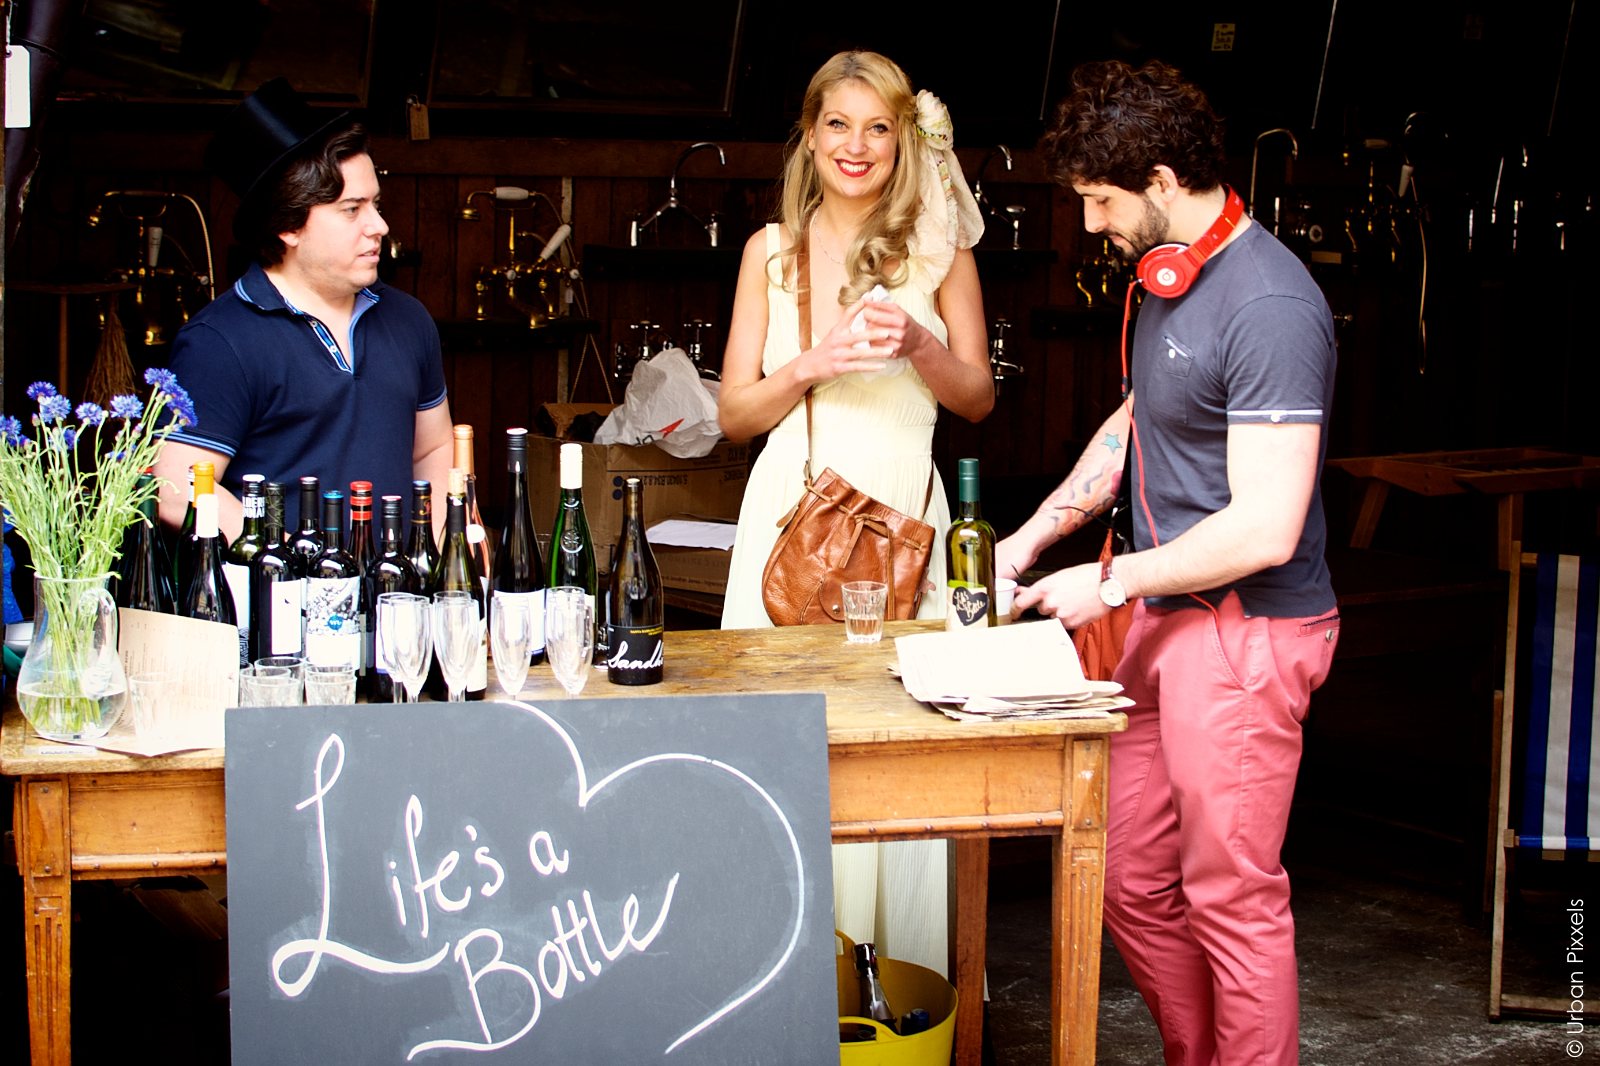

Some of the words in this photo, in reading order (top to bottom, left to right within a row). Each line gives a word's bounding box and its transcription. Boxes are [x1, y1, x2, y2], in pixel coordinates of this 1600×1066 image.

[272, 733, 504, 997] Life's
[528, 831, 568, 875] a
[407, 873, 680, 1061] Bottle
